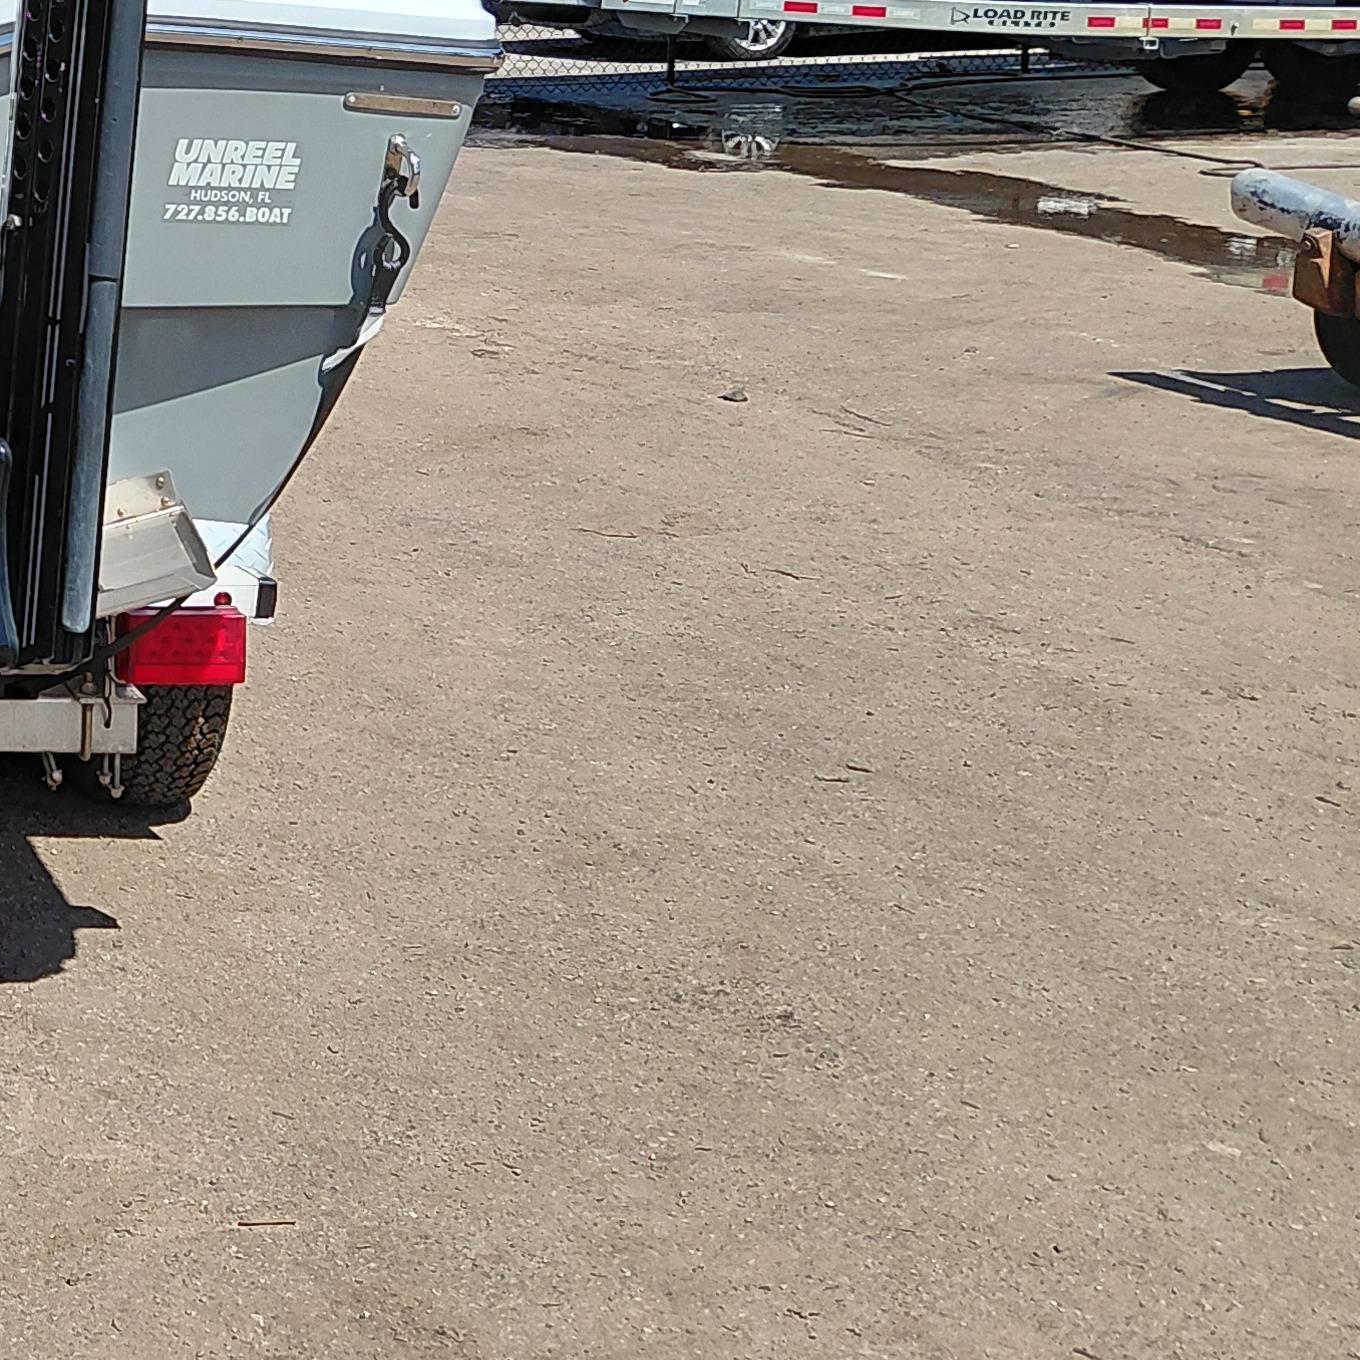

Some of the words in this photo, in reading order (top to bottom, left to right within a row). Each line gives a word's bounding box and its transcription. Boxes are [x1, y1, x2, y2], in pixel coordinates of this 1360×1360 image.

[972, 8, 1026, 20] LOAD
[1030, 10, 1071, 21] RITE
[175, 139, 302, 166] UNREEL
[168, 162, 300, 190] MARINE
[190, 190, 254, 205] HUDSON,
[257, 191, 272, 204] FL
[163, 204, 292, 224] 727.856.BOAT
